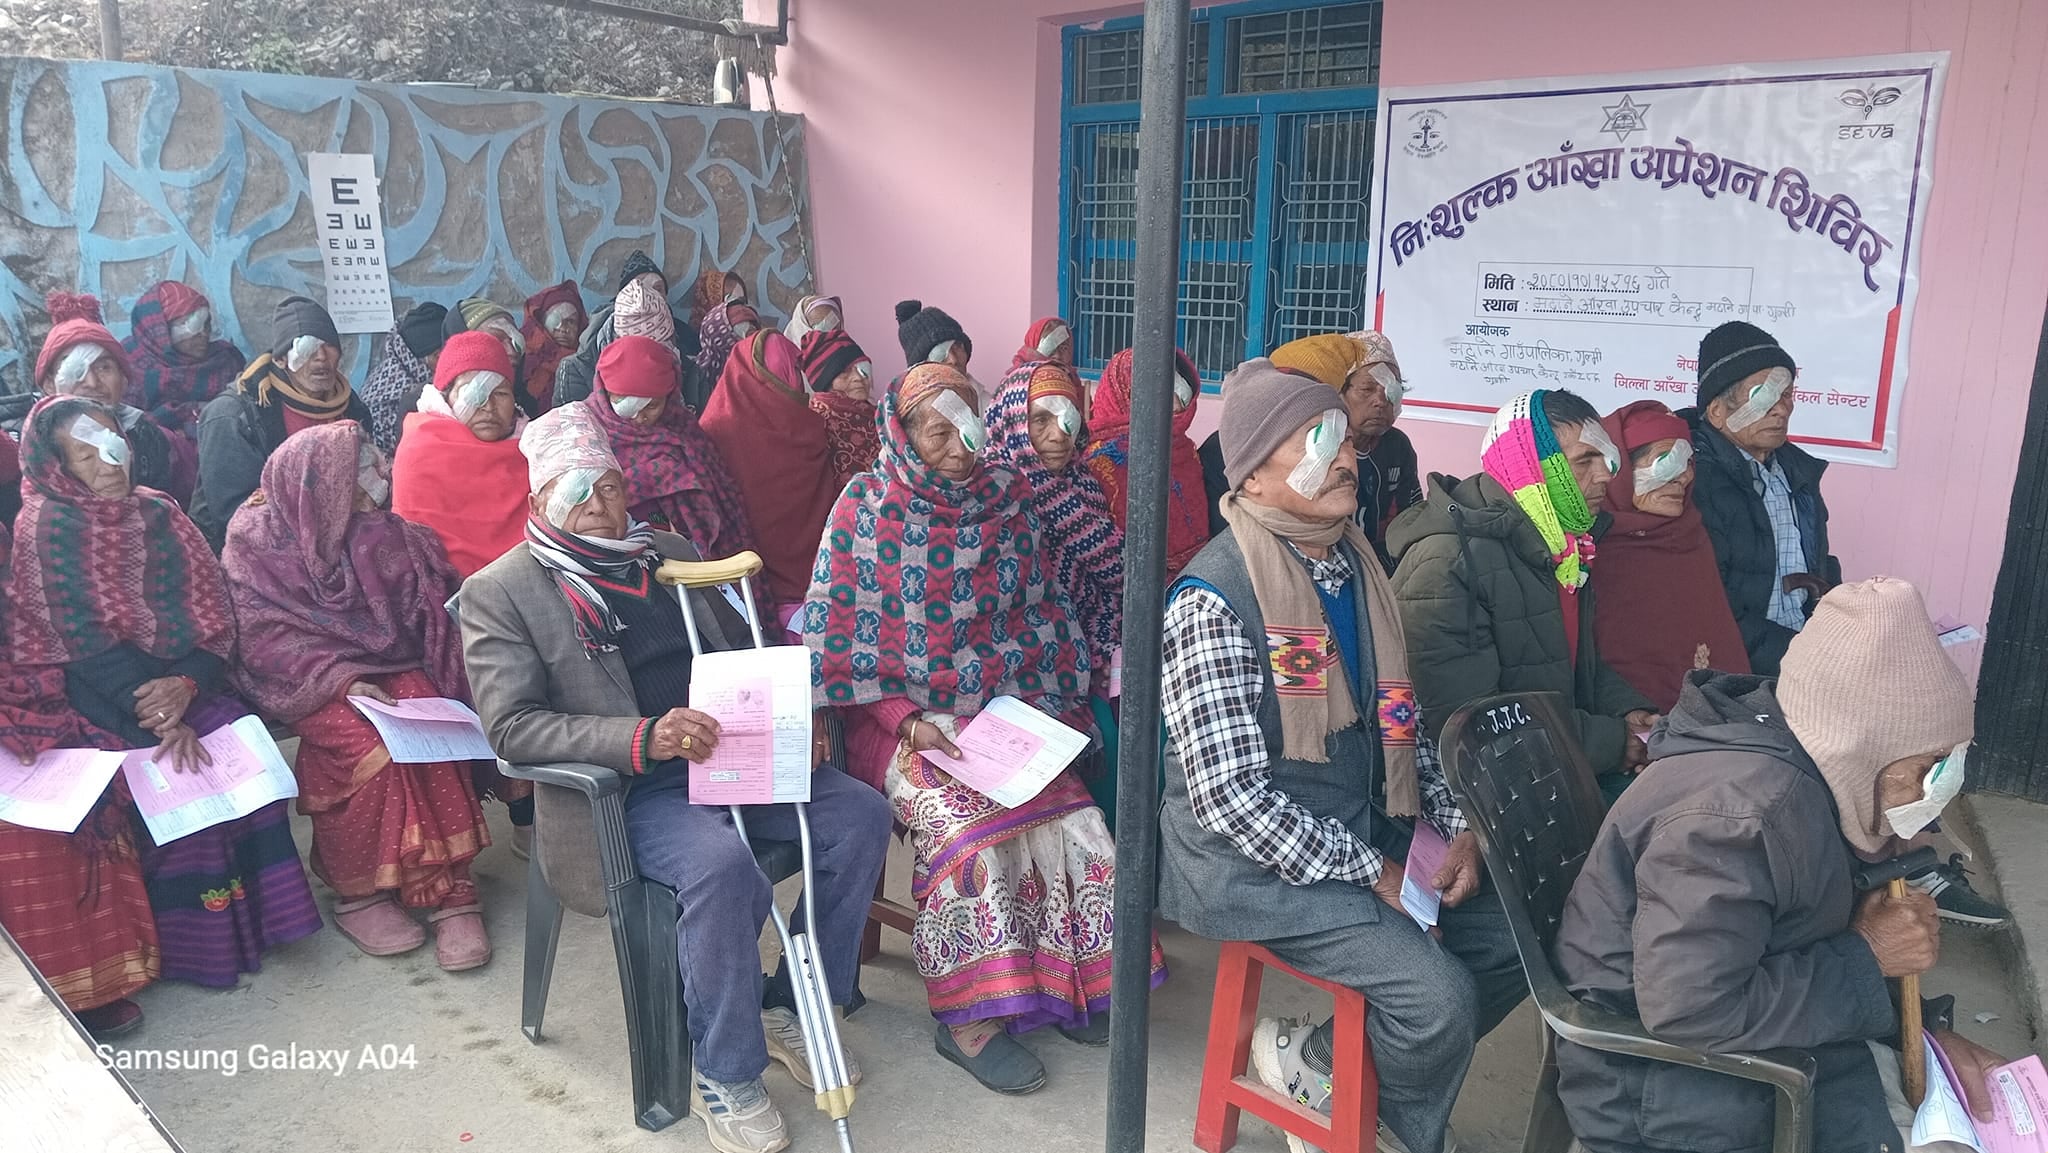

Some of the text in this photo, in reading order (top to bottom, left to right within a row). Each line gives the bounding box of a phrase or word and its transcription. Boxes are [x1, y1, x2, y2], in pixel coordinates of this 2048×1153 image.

[331, 178, 360, 205] E
[1525, 139, 1625, 190] आँखा
[1630, 136, 1769, 202] अप्रेशन
[1766, 166, 1894, 293] शिविर
[1484, 272, 1516, 291] मिति
[1482, 297, 1520, 313] स्थान
[1465, 320, 1511, 337] आयोजक
[1677, 354, 1699, 372] नेपा
[1614, 372, 1651, 391] जिल्ला
[1654, 375, 1689, 394] आँखा
[1827, 388, 1870, 409] सेन्टर
